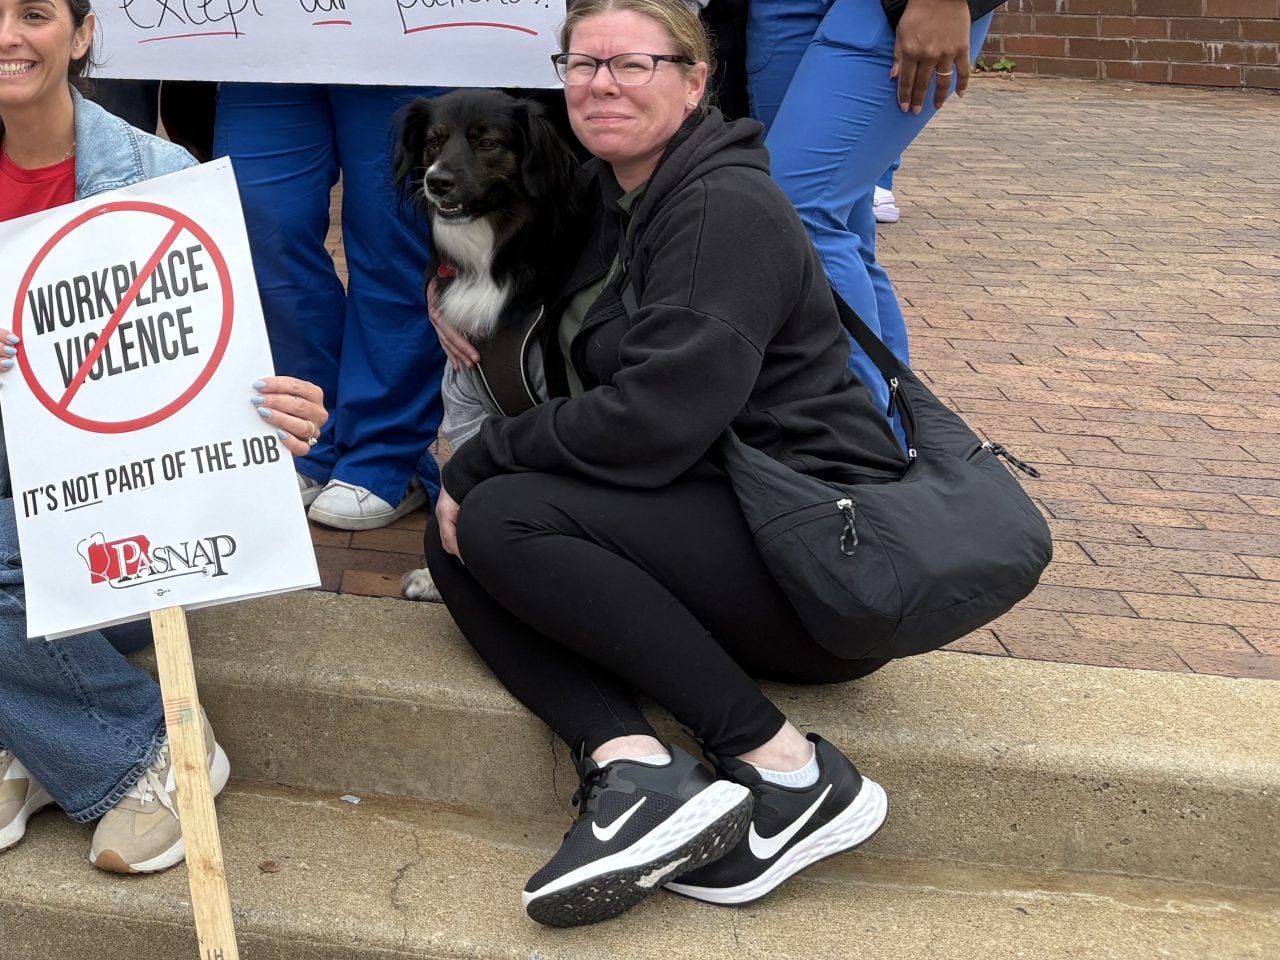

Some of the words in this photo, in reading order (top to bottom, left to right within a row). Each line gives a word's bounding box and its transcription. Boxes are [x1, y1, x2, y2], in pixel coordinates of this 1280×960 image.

[27, 244, 210, 336] WORKPLACE
[53, 305, 200, 389] VIOLENCE
[22, 483, 59, 518] IT'S
[62, 471, 99, 507] NOT
[105, 457, 156, 496] PART
[161, 450, 187, 482] OF
[190, 440, 237, 475] THE
[242, 434, 281, 467] JOB
[111, 534, 238, 583] PASNAP
